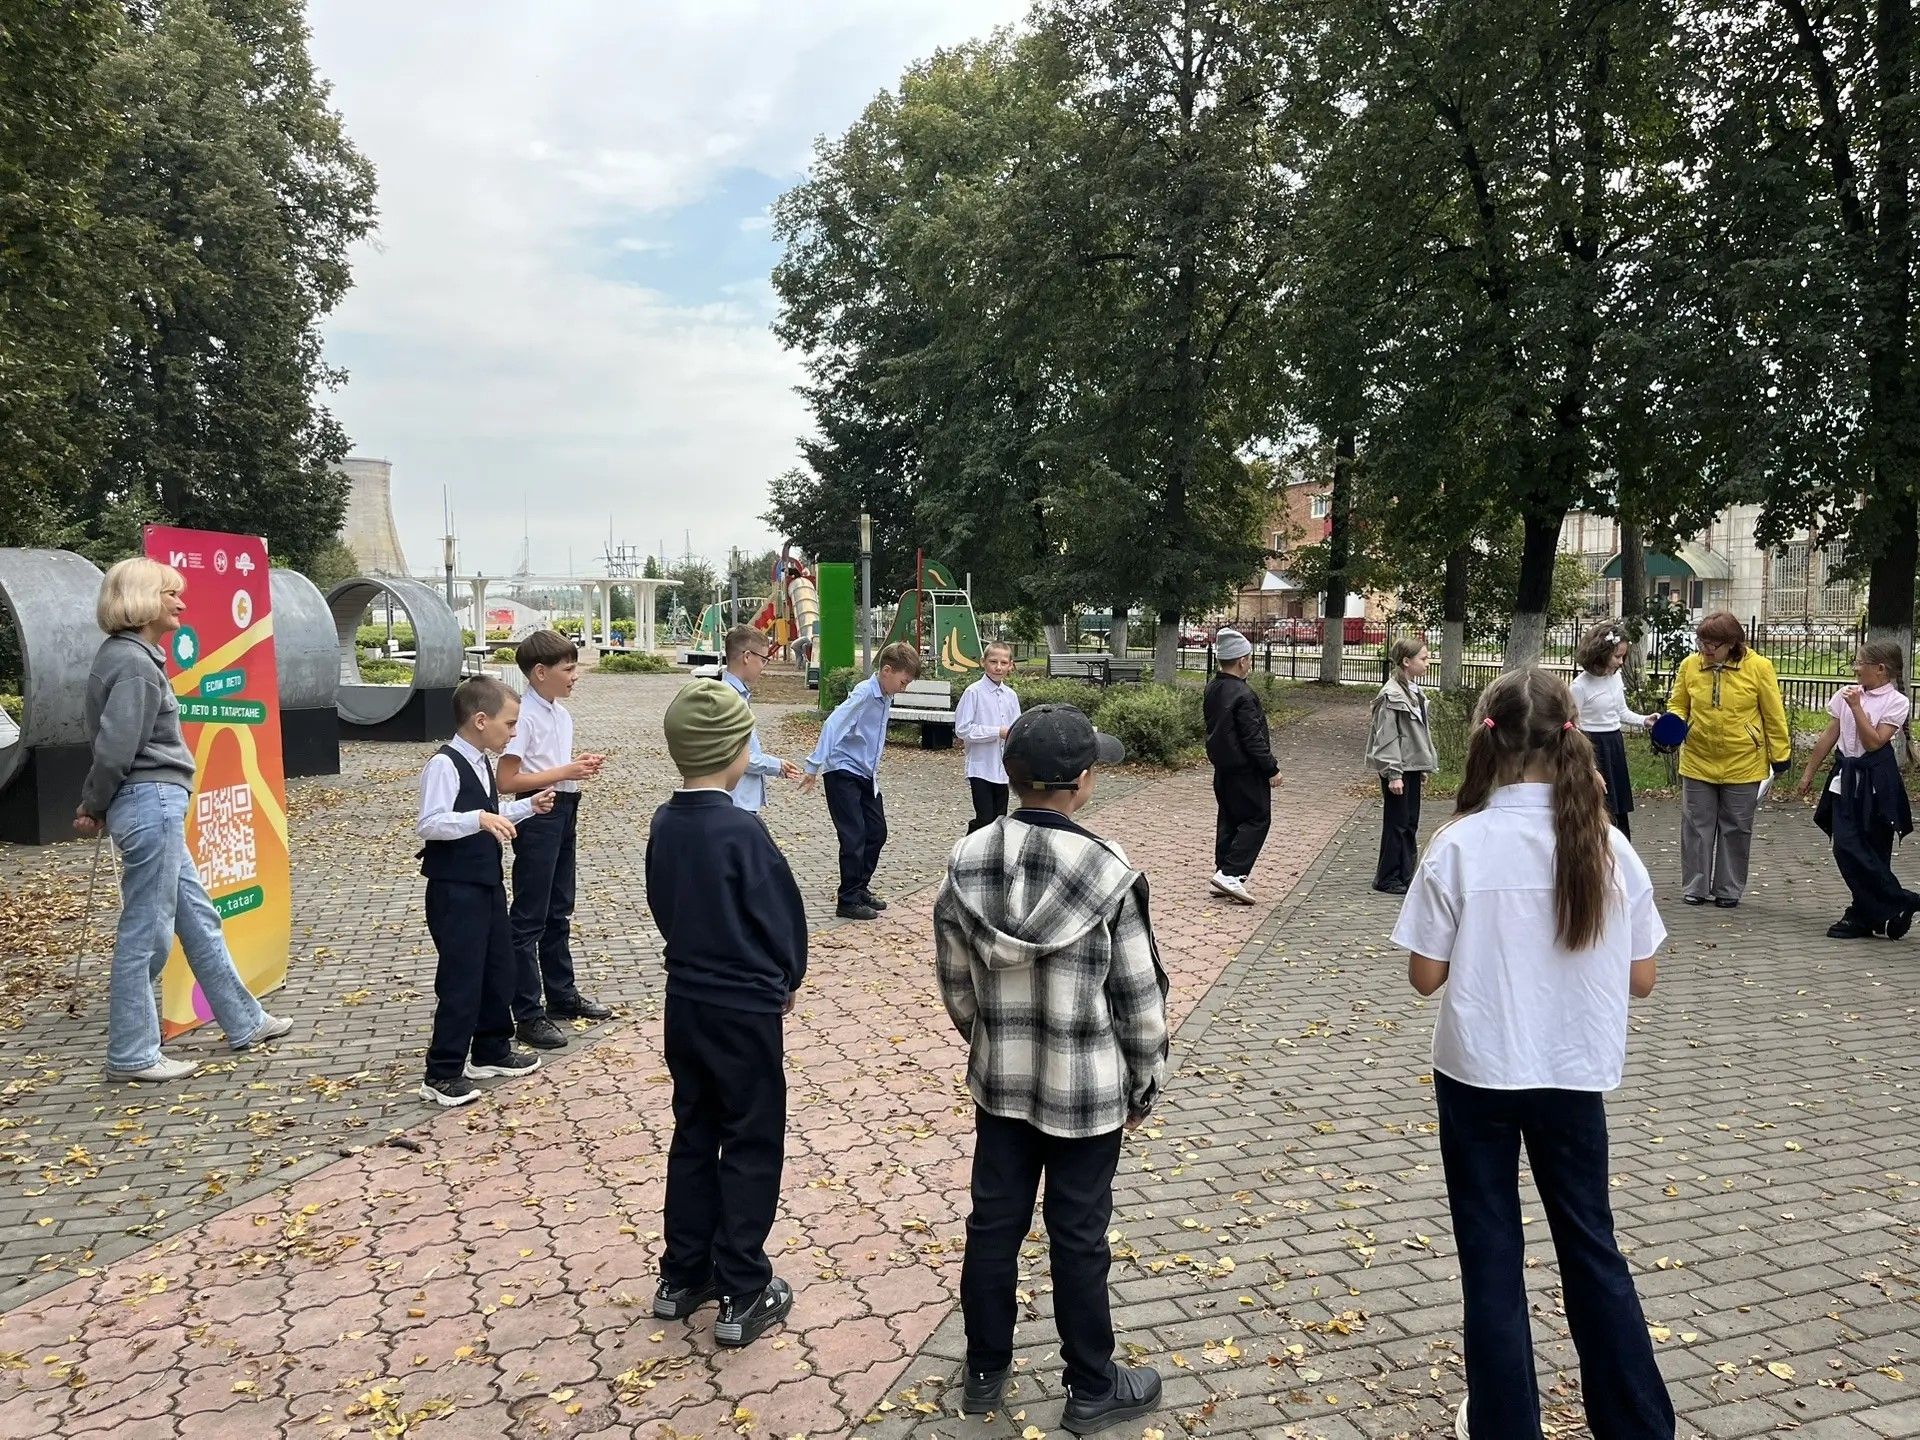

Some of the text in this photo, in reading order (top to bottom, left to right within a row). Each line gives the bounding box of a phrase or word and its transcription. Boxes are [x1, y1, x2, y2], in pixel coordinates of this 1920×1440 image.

[205, 676, 241, 692] ЕСЛИ ЛЕТО
[178, 704, 260, 718] ТО ЛЕТО В ТАТАРСТАНЕ
[215, 894, 254, 913] o.tatar
